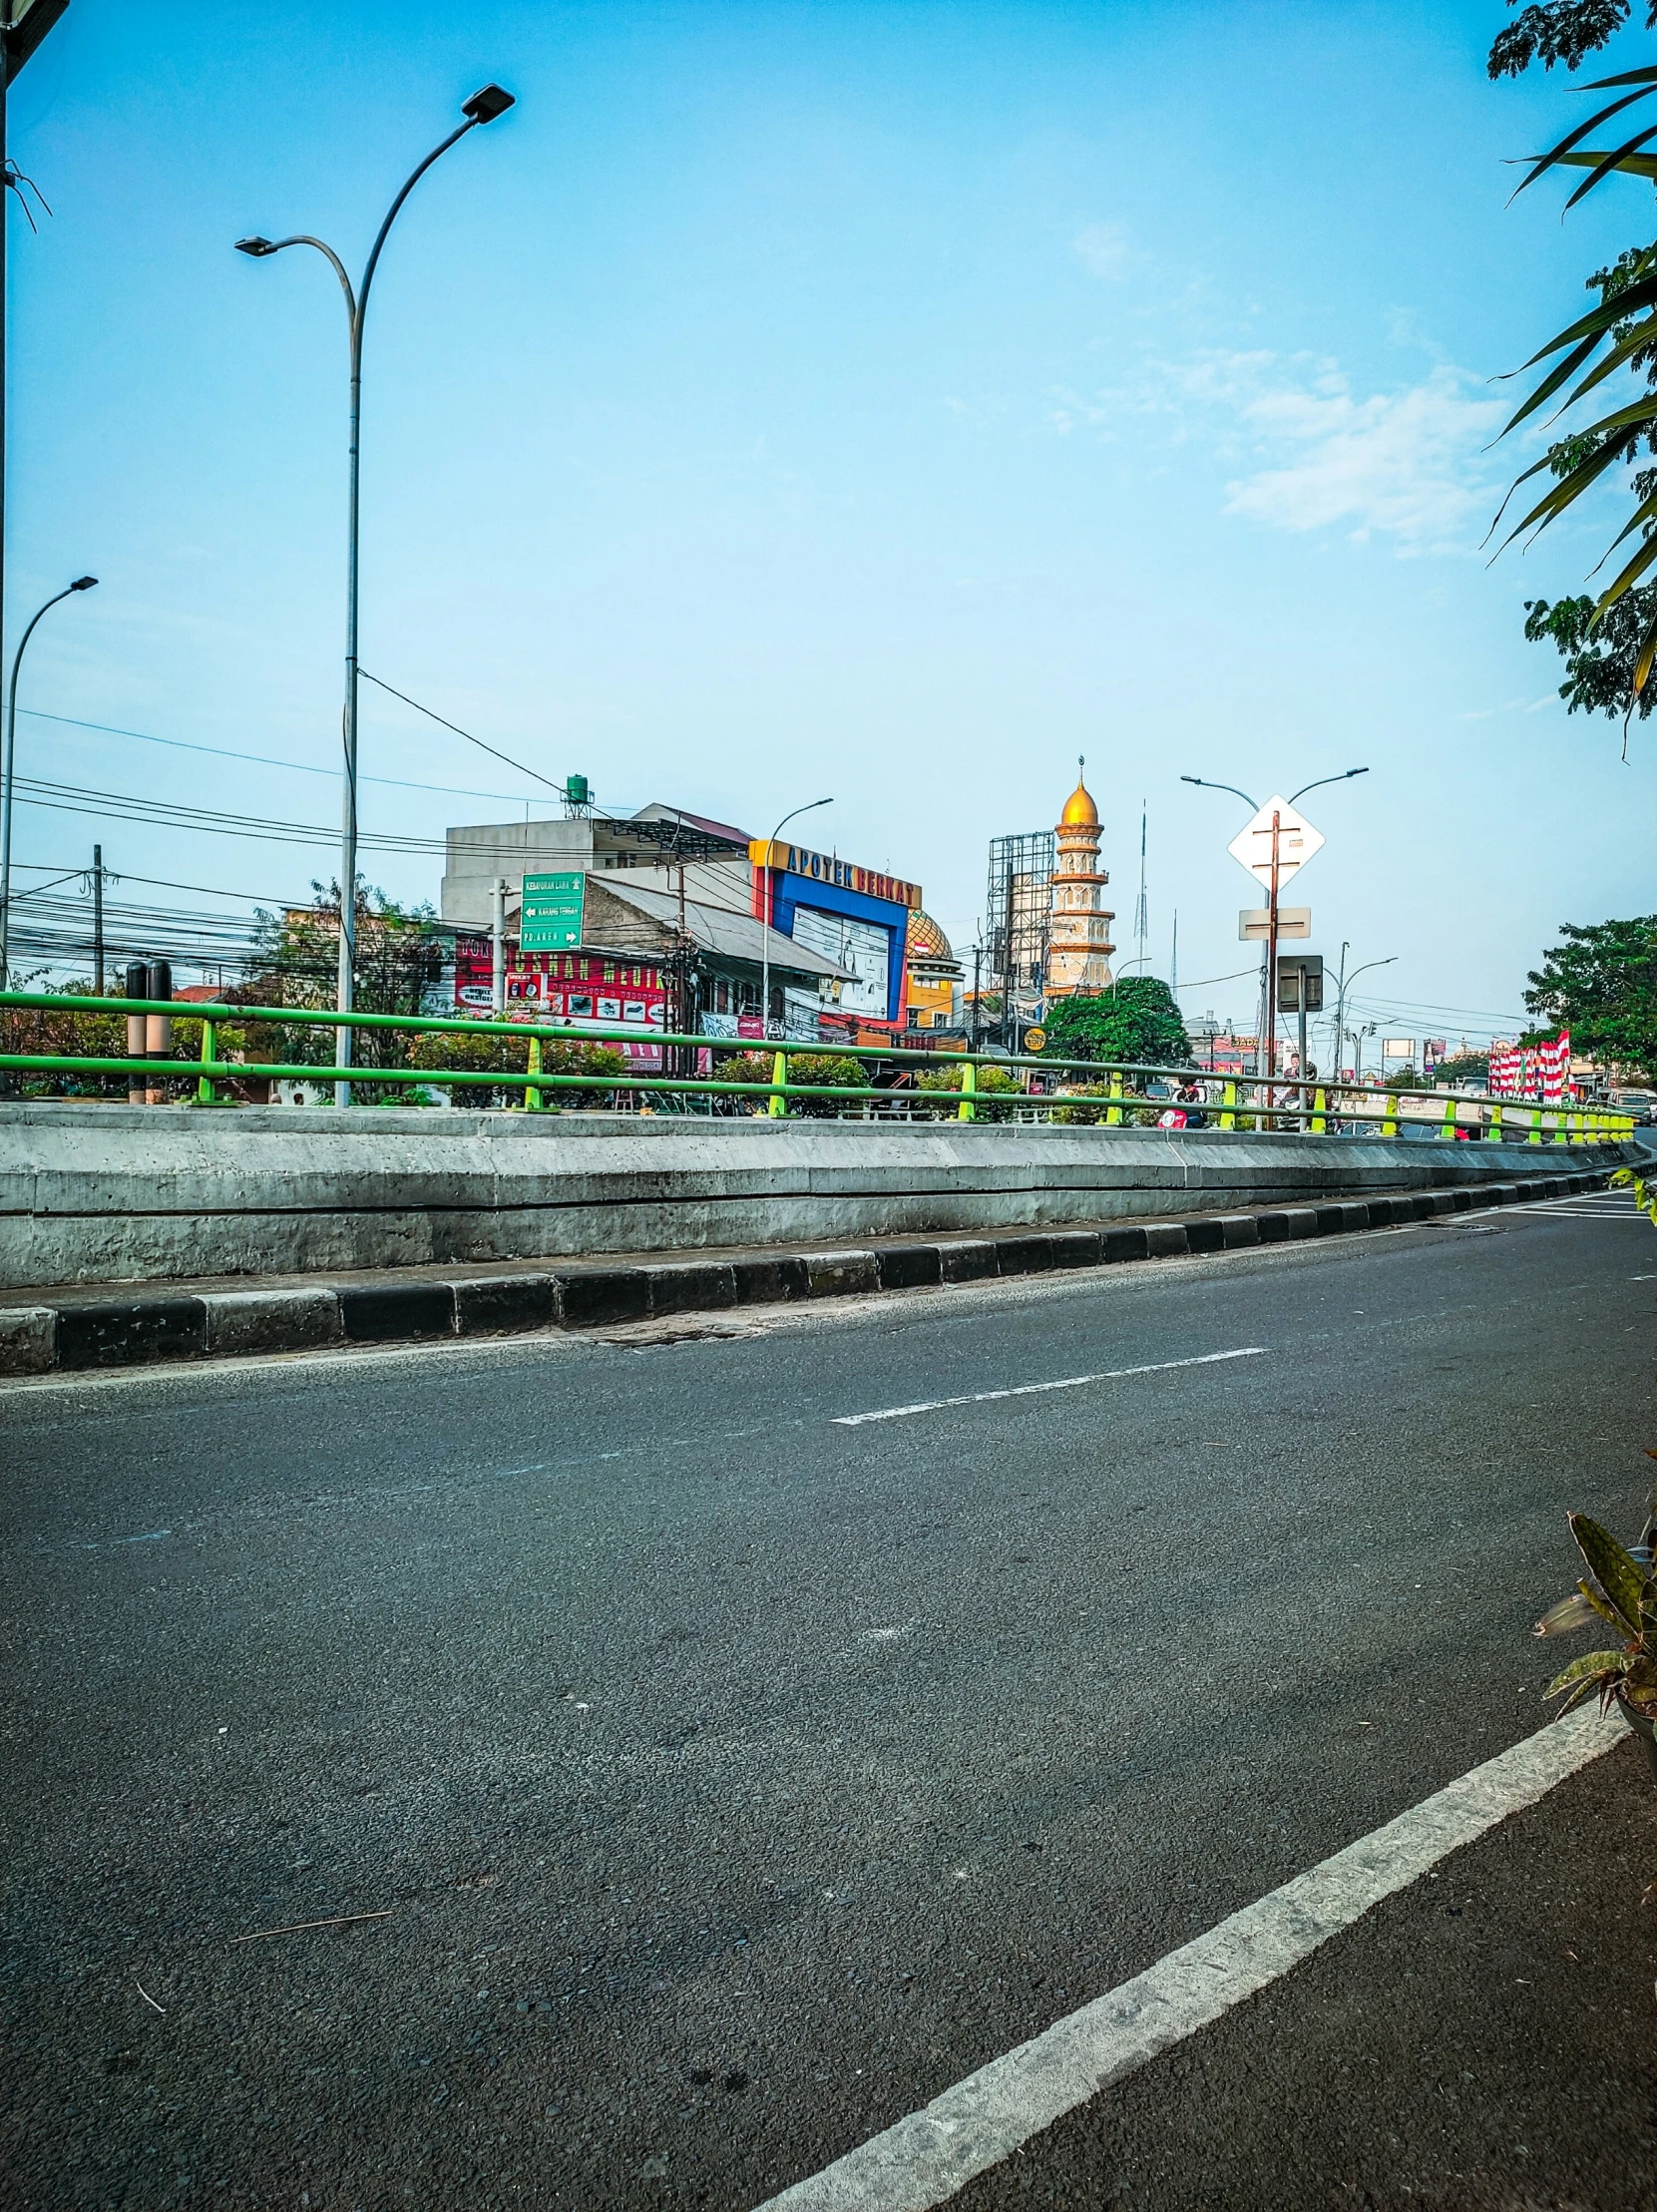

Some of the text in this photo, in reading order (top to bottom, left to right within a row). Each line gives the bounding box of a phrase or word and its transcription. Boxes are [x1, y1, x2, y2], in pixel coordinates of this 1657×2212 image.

[787, 846, 914, 906] APOTEK BERKAT
[539, 907, 559, 917] KARANG
[462, 939, 493, 958] TOK
